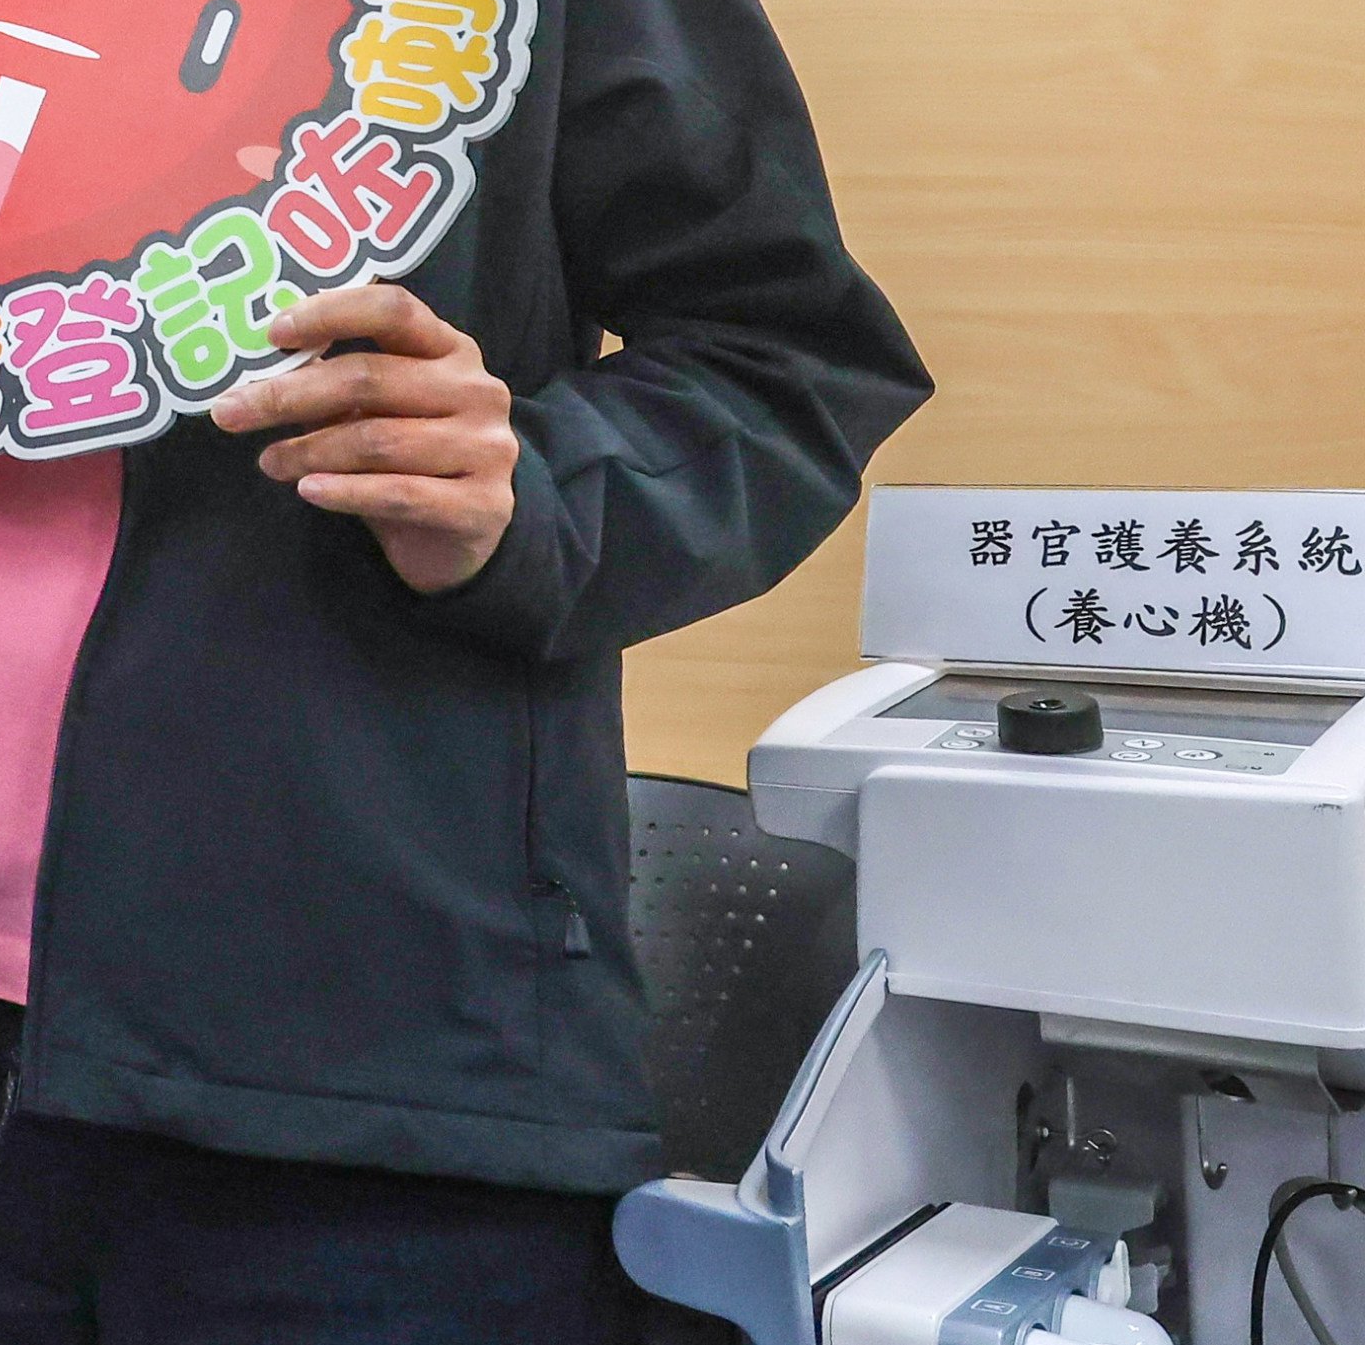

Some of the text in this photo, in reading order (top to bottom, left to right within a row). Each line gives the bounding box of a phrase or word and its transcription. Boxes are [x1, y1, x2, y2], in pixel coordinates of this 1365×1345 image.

[969, 517, 1363, 576] 器官護養系統
